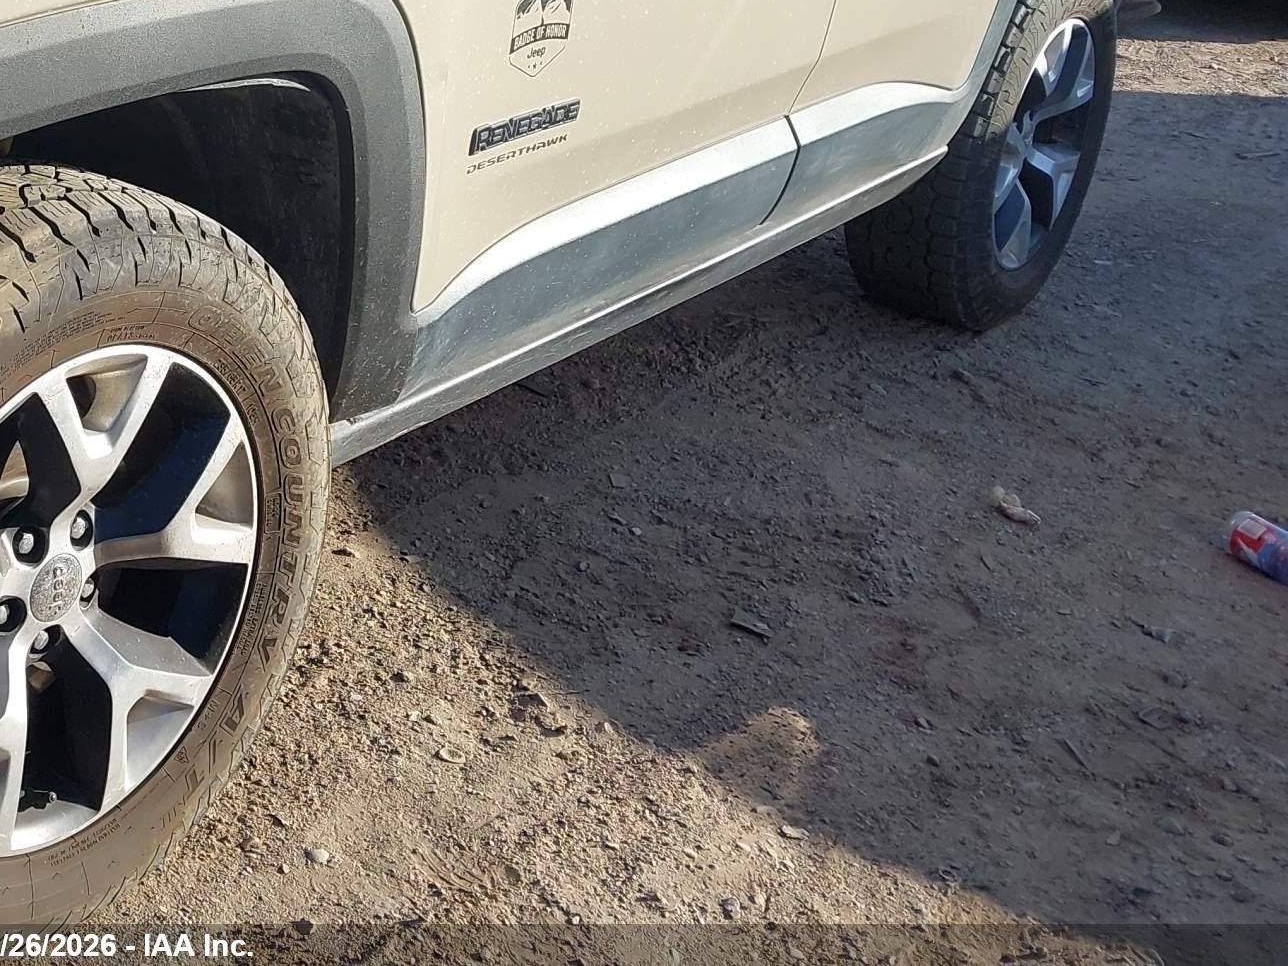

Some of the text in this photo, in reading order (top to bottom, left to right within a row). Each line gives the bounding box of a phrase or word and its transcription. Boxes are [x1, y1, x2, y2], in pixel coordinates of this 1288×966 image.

[512, 23, 568, 52] BADGE OF HONOR
[526, 45, 547, 60] Jeep
[468, 97, 581, 156] RENEGADE
[466, 133, 568, 175] DESERTHAWK
